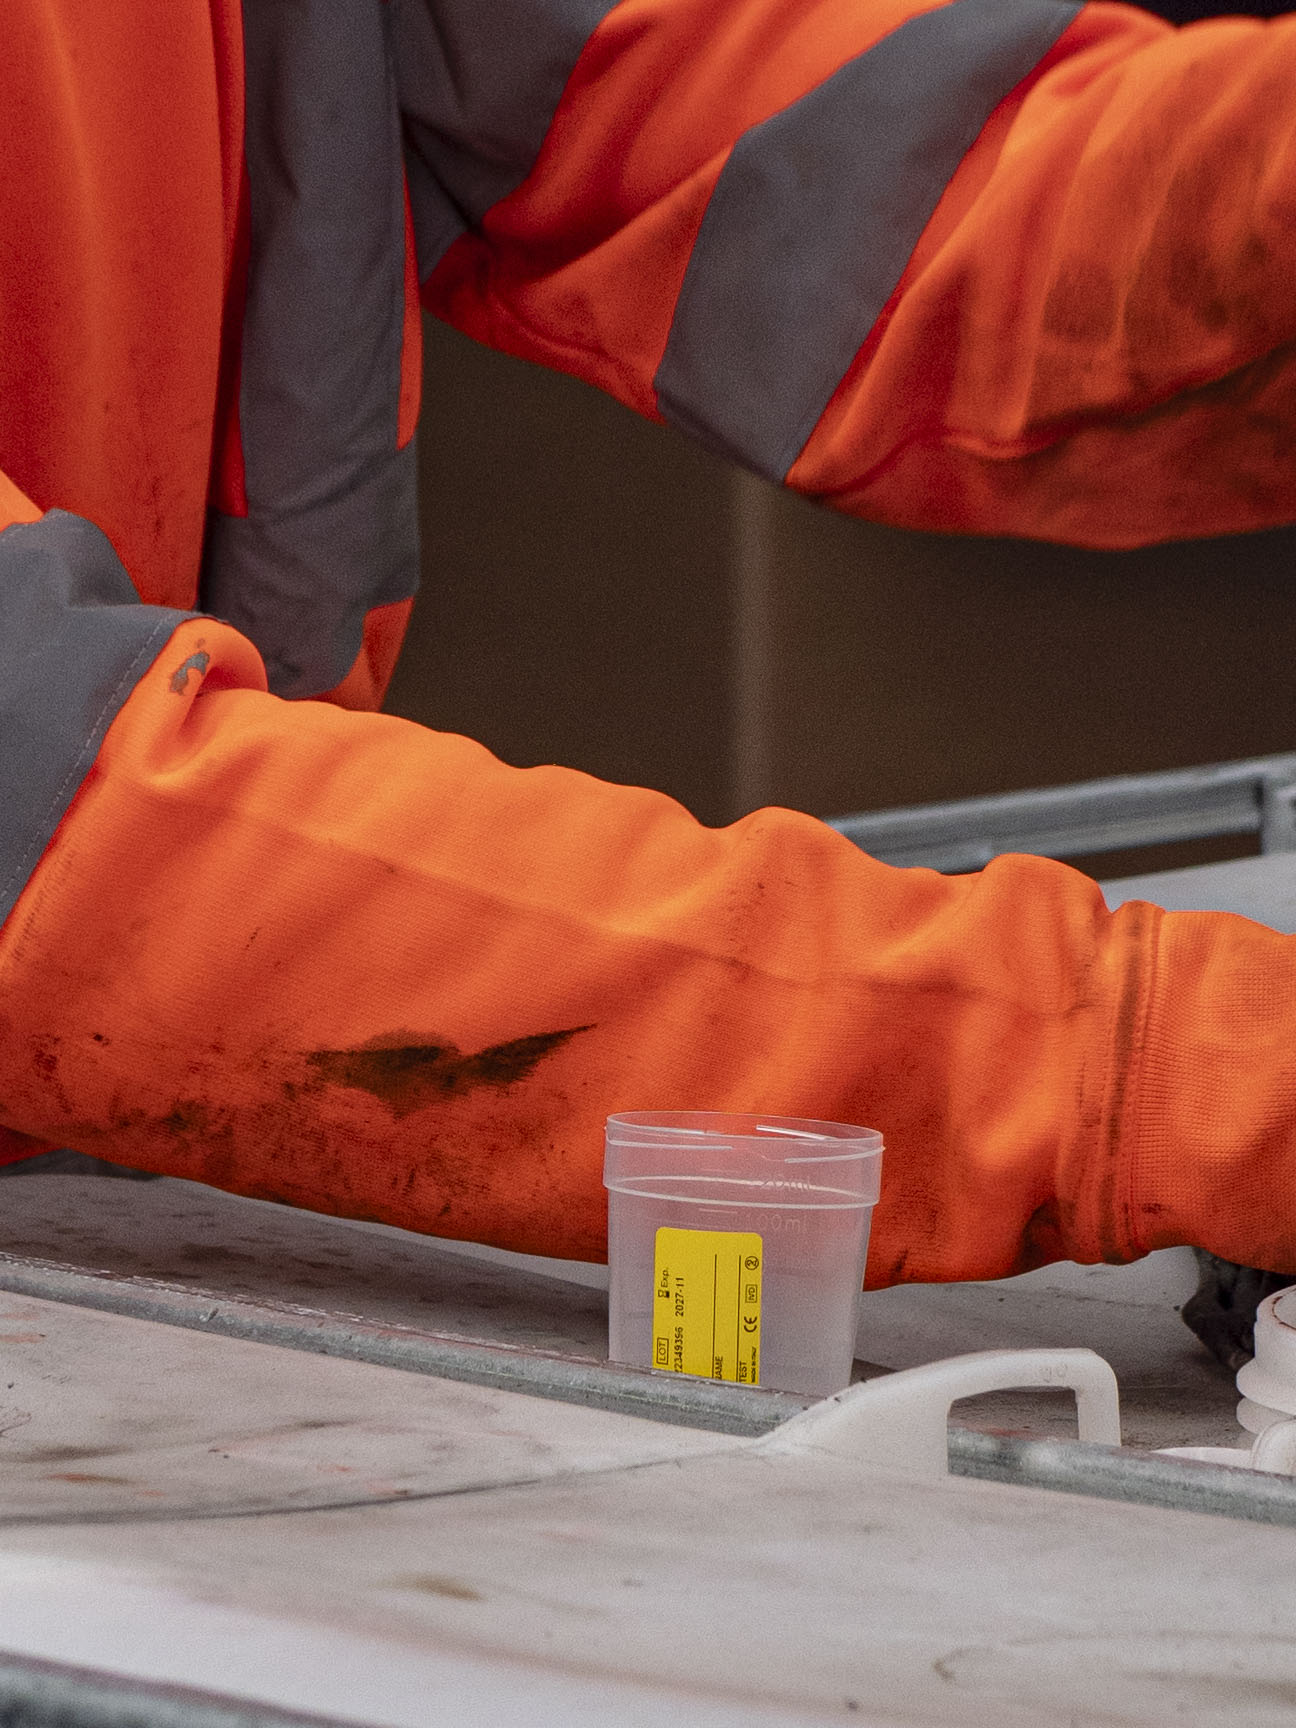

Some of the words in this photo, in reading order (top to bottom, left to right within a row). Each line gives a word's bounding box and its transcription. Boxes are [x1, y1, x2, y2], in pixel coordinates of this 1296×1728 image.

[675, 1277, 685, 1317] 2027-11
[658, 1341, 666, 1362] LOT
[739, 1360, 747, 1384] TEST
